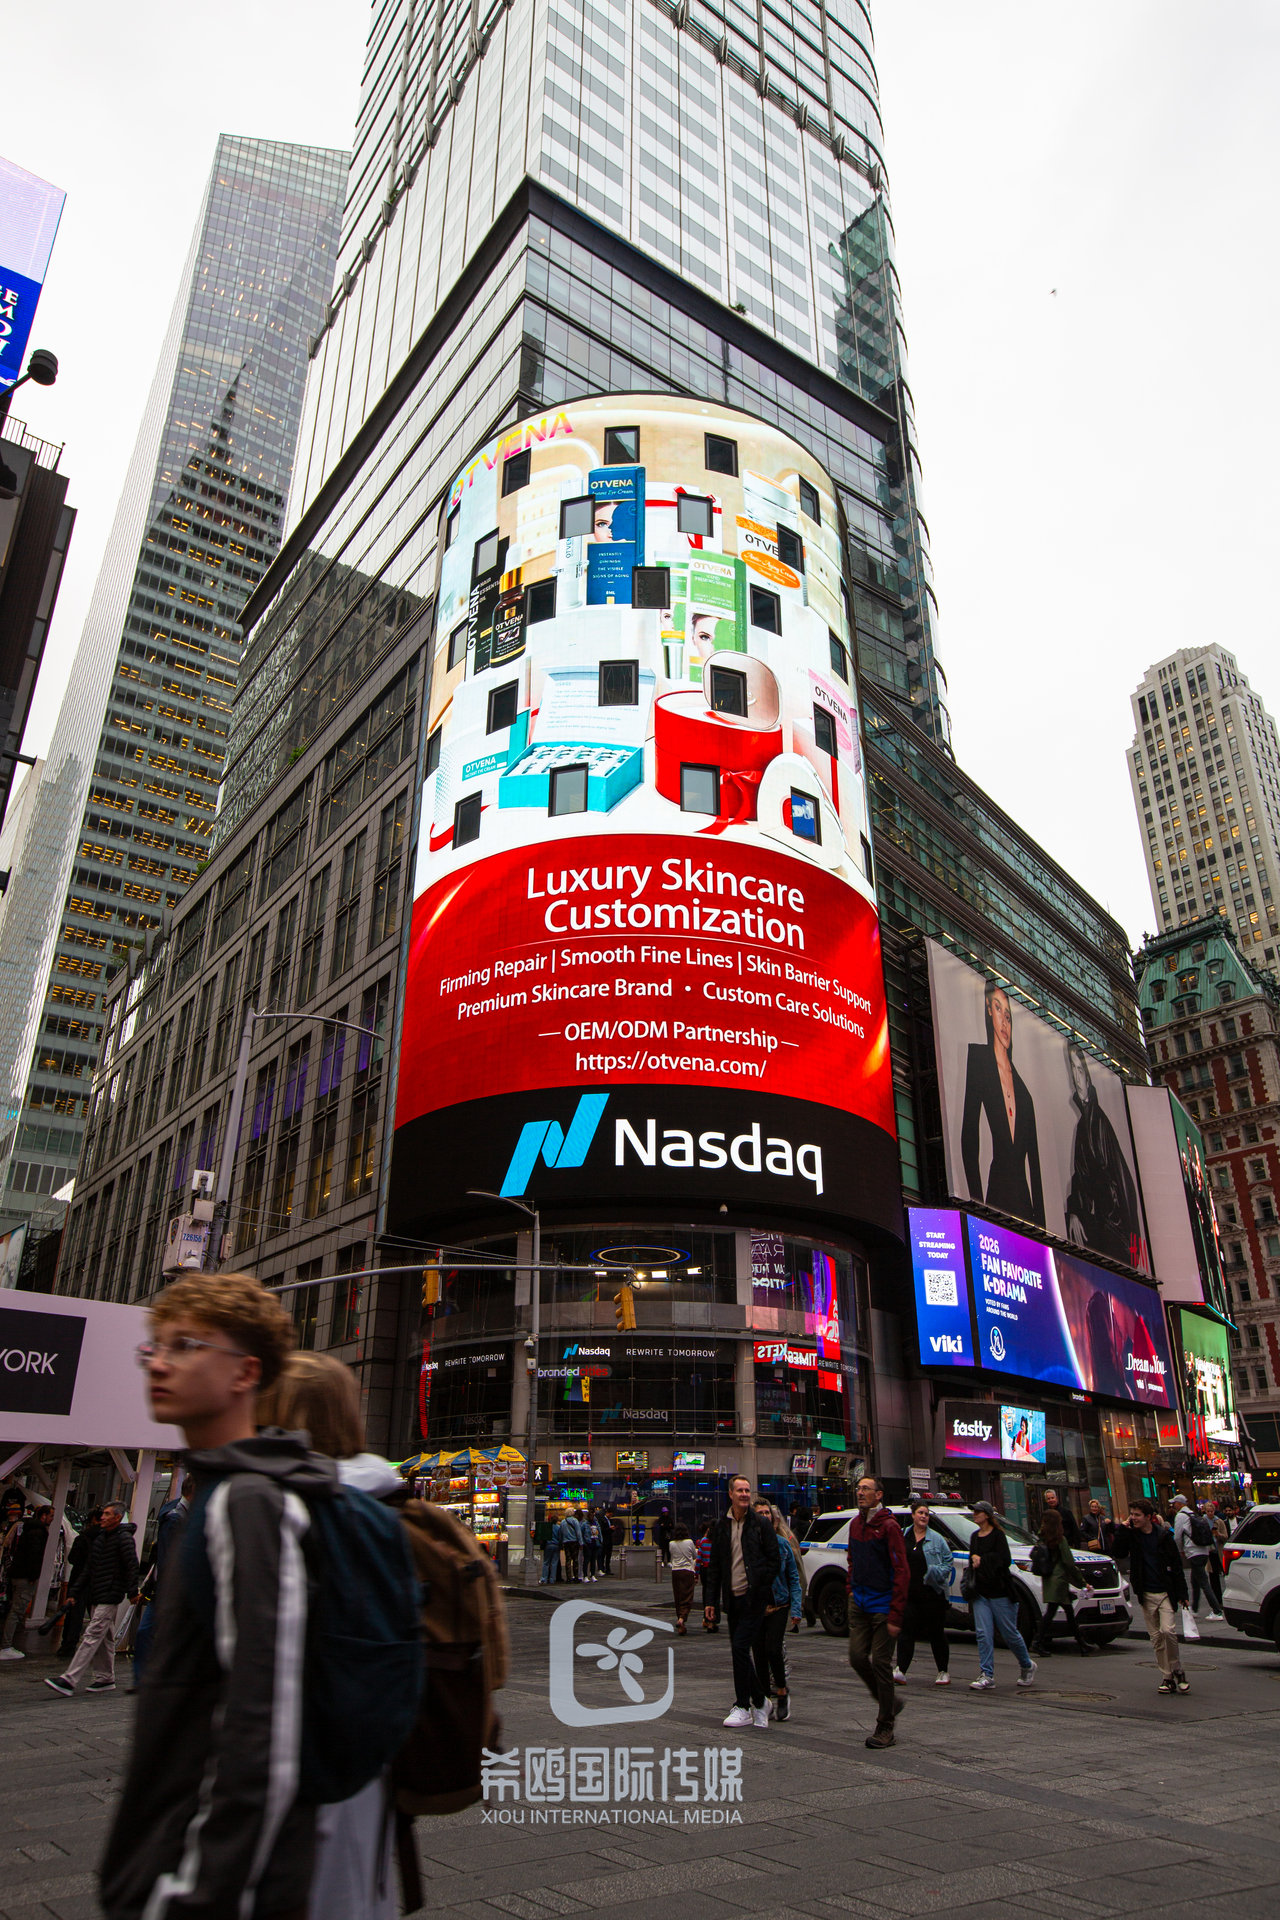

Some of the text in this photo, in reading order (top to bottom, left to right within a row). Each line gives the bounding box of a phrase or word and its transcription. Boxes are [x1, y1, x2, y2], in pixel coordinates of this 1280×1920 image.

[451, 412, 573, 506] OTVENA
[590, 479, 634, 490] OTVENA
[745, 534, 779, 556] OTVE
[693, 561, 732, 576] OTVENA
[479, 580, 500, 595] ESSENTI
[467, 583, 480, 650] OTVENA
[815, 685, 848, 724] OTVENA
[465, 756, 496, 773] OTVENA
[527, 858, 806, 914] Luxury Skincare
[544, 899, 805, 951] Customization
[440, 945, 872, 1016] Firming Repair Smooth Fine Lines Skin Barrier Support
[457, 978, 866, 1040] Premium Skincare Brand Custom Care Solutions
[565, 1021, 779, 1054] OEM/ODM Partnership
[575, 1050, 767, 1079] https://otvena.com/
[615, 1118, 824, 1196] Nasdaq
[918, 1241, 956, 1250] STREAMING
[925, 1231, 946, 1239] START
[978, 1233, 1000, 1255] 2026
[927, 1251, 949, 1259] TODAY
[981, 1252, 1043, 1290] FAN FAVORITE
[983, 1273, 1027, 1304] K-DRAMA
[985, 1298, 996, 1307] VOTED
[1001, 1302, 1010, 1311] FANS
[986, 1306, 1000, 1316] AROUND
[1007, 1311, 1019, 1321] WORLD
[578, 1346, 716, 1357] Nasdaq REWRITE TOMORROW
[929, 1334, 963, 1353] Viki
[444, 1357, 467, 1367] REWRITE
[469, 1353, 505, 1364] TOMORROW
[538, 1365, 608, 1377] brandedcities
[1125, 1352, 1149, 1372] Dream
[1152, 1354, 1167, 1374] You
[623, 1407, 669, 1421] Nasdaq
